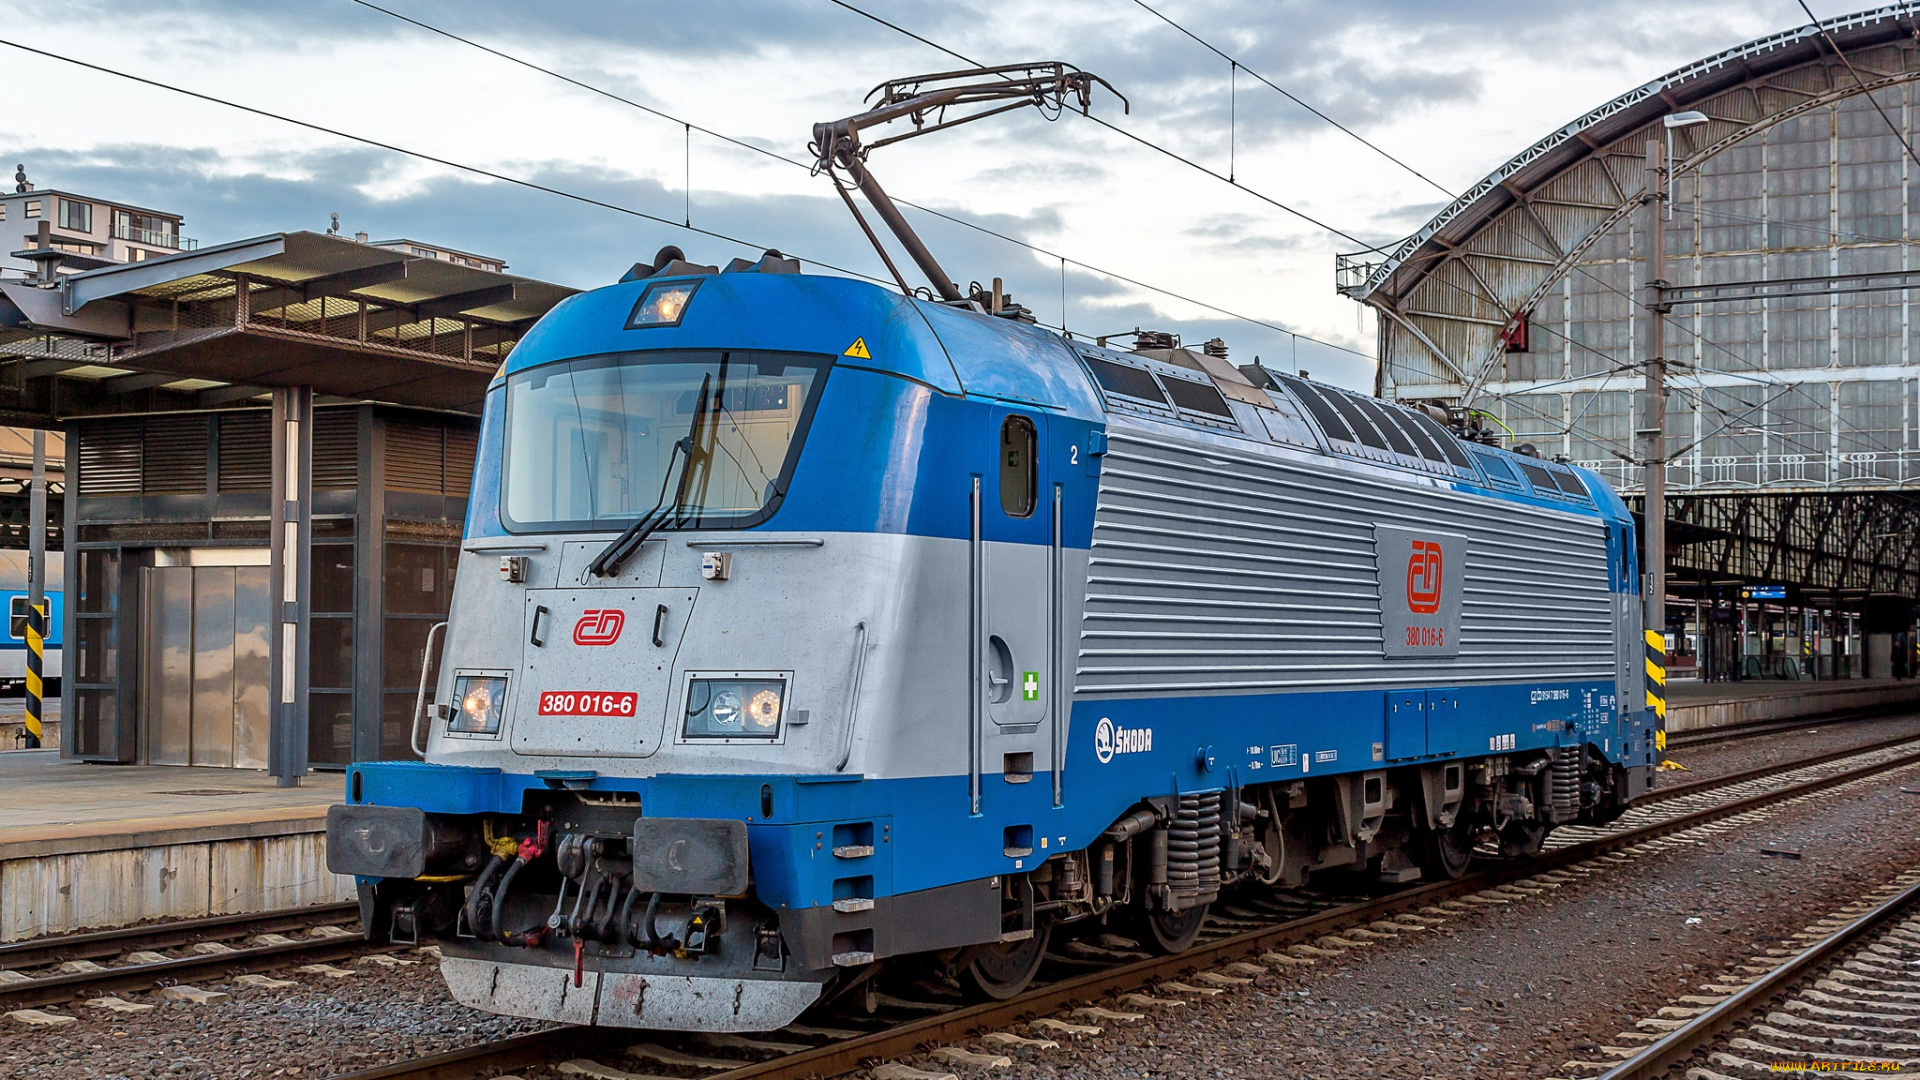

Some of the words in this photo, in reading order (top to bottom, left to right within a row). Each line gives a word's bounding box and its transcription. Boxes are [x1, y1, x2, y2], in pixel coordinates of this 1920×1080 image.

[1070, 444, 1078, 465] 2
[1405, 626, 1420, 646] 380
[1421, 627, 1444, 647] 016-6
[542, 694, 576, 713] 380
[579, 694, 633, 714] 016-6
[1115, 725, 1153, 755] ŠKODA
